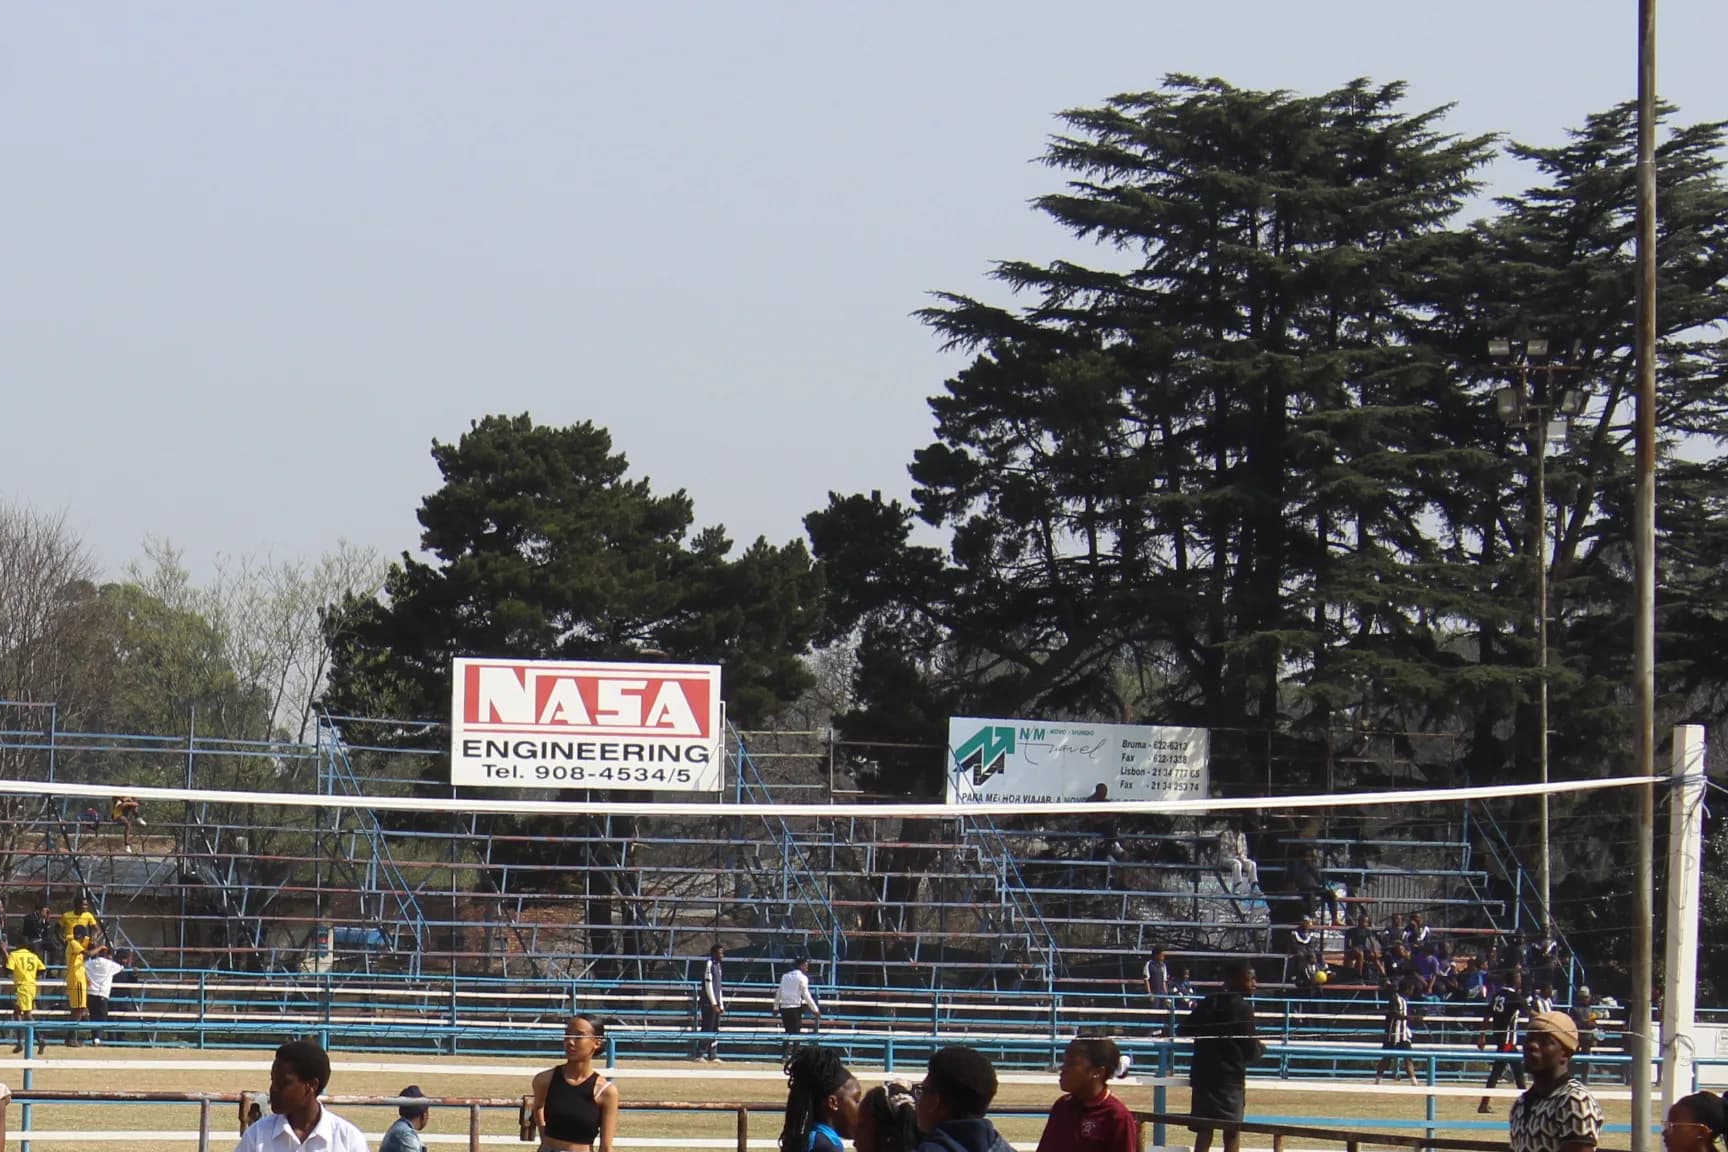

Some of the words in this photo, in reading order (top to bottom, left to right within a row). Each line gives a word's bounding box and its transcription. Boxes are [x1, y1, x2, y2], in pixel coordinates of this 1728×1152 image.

[477, 667, 702, 736] NASA
[1122, 740, 1147, 749] Bruma
[462, 740, 709, 763] ENGINEERING
[1121, 753, 1135, 762] Fax
[482, 765, 524, 779] Tel.
[535, 766, 691, 783] 908-4534/5
[1120, 767, 1145, 776] Lisbon
[1120, 780, 1133, 789] Fax
